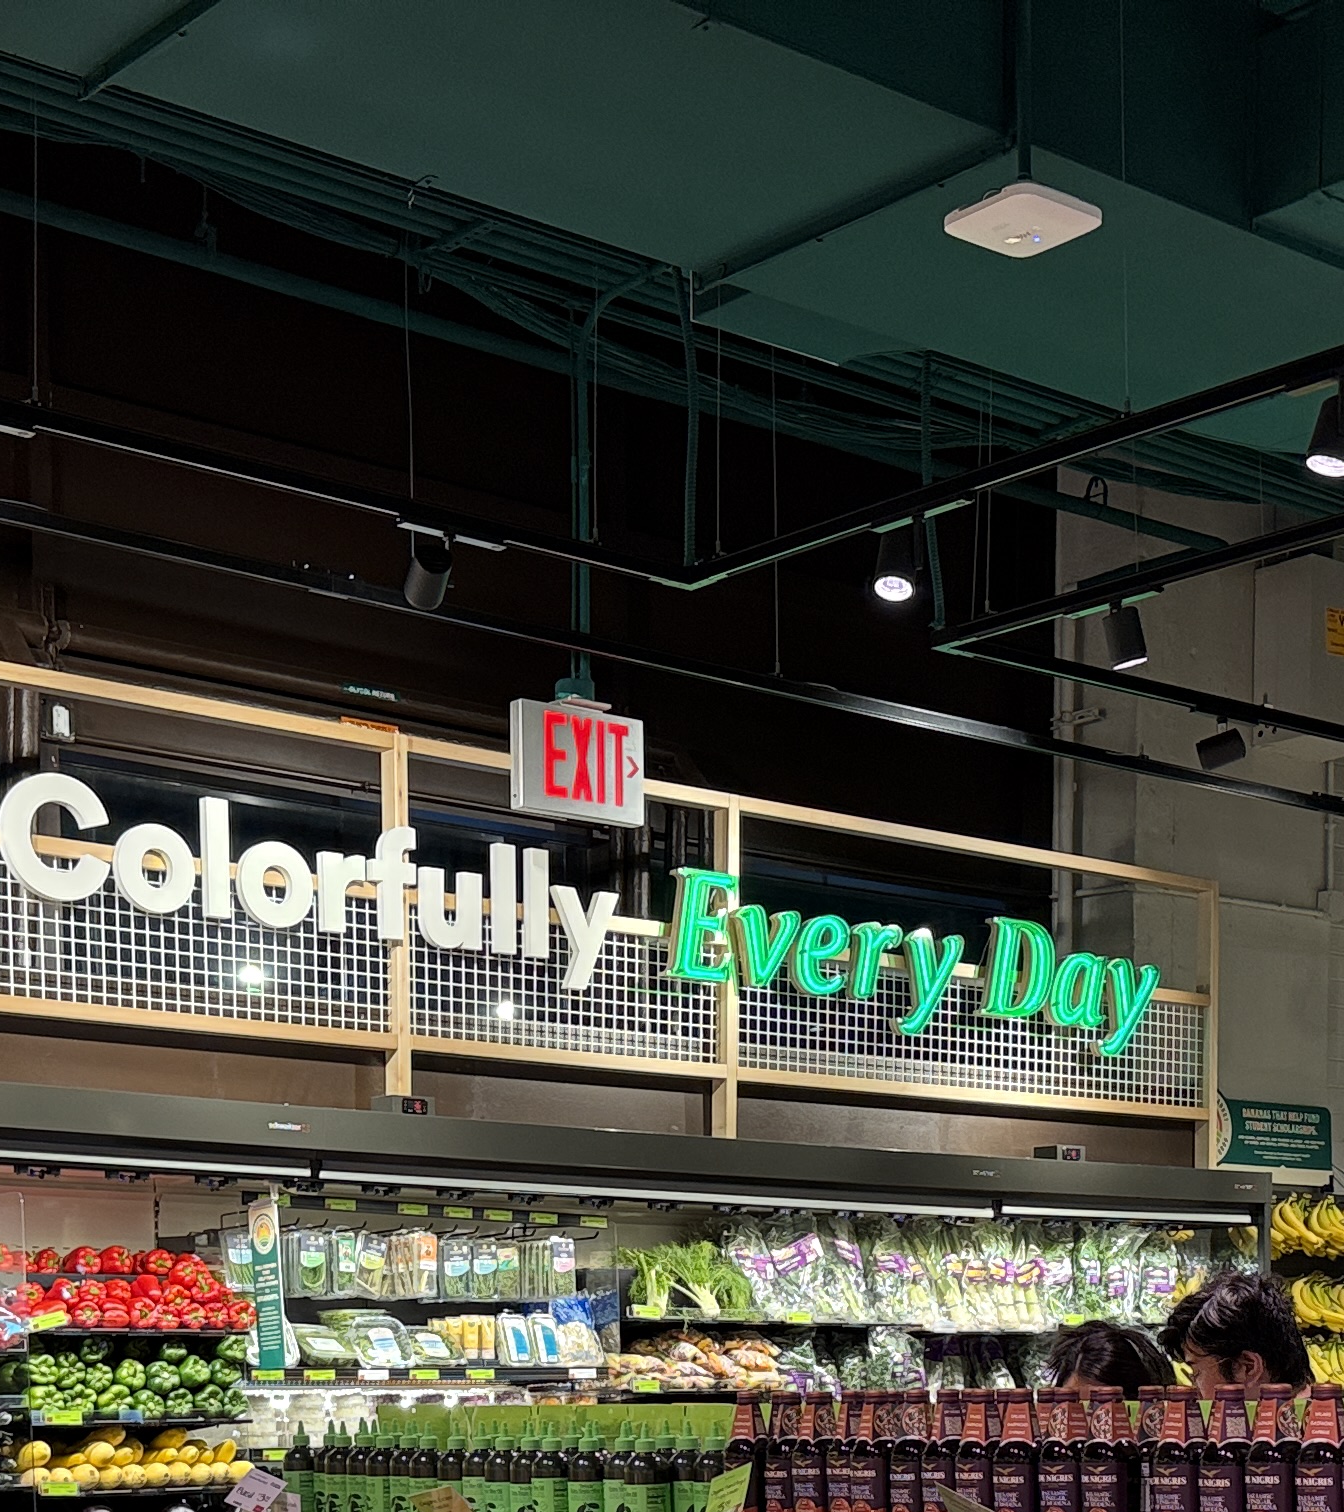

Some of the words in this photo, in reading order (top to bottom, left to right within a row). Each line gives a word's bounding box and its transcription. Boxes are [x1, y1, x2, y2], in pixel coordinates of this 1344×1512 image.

[543, 710, 629, 808] EXIT
[664, 867, 965, 1036] Every
[975, 916, 1161, 1058] Day
[1252, 1476, 1280, 1485] NIGRIS
[1303, 1477, 1333, 1486] NIGRIS
